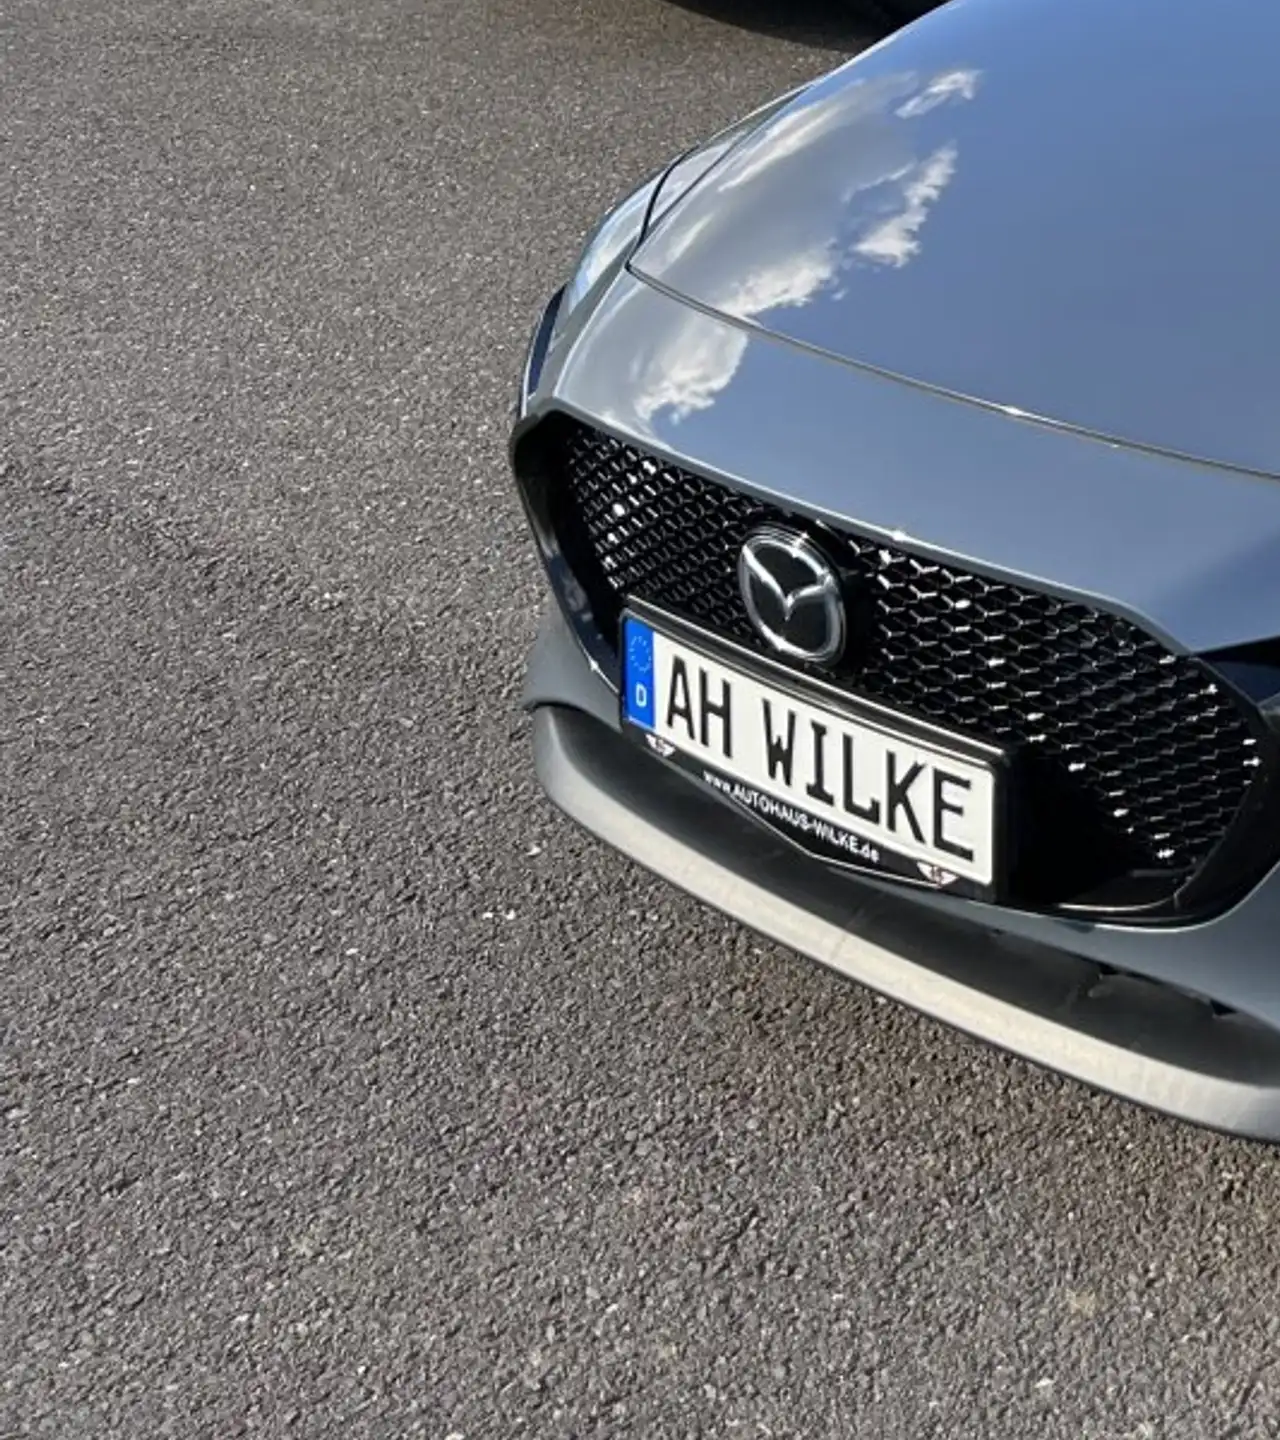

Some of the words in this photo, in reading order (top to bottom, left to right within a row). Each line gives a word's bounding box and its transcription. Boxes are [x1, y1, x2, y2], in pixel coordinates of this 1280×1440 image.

[635, 681, 648, 708] D
[665, 654, 733, 759] AH
[762, 697, 975, 863] WILKE
